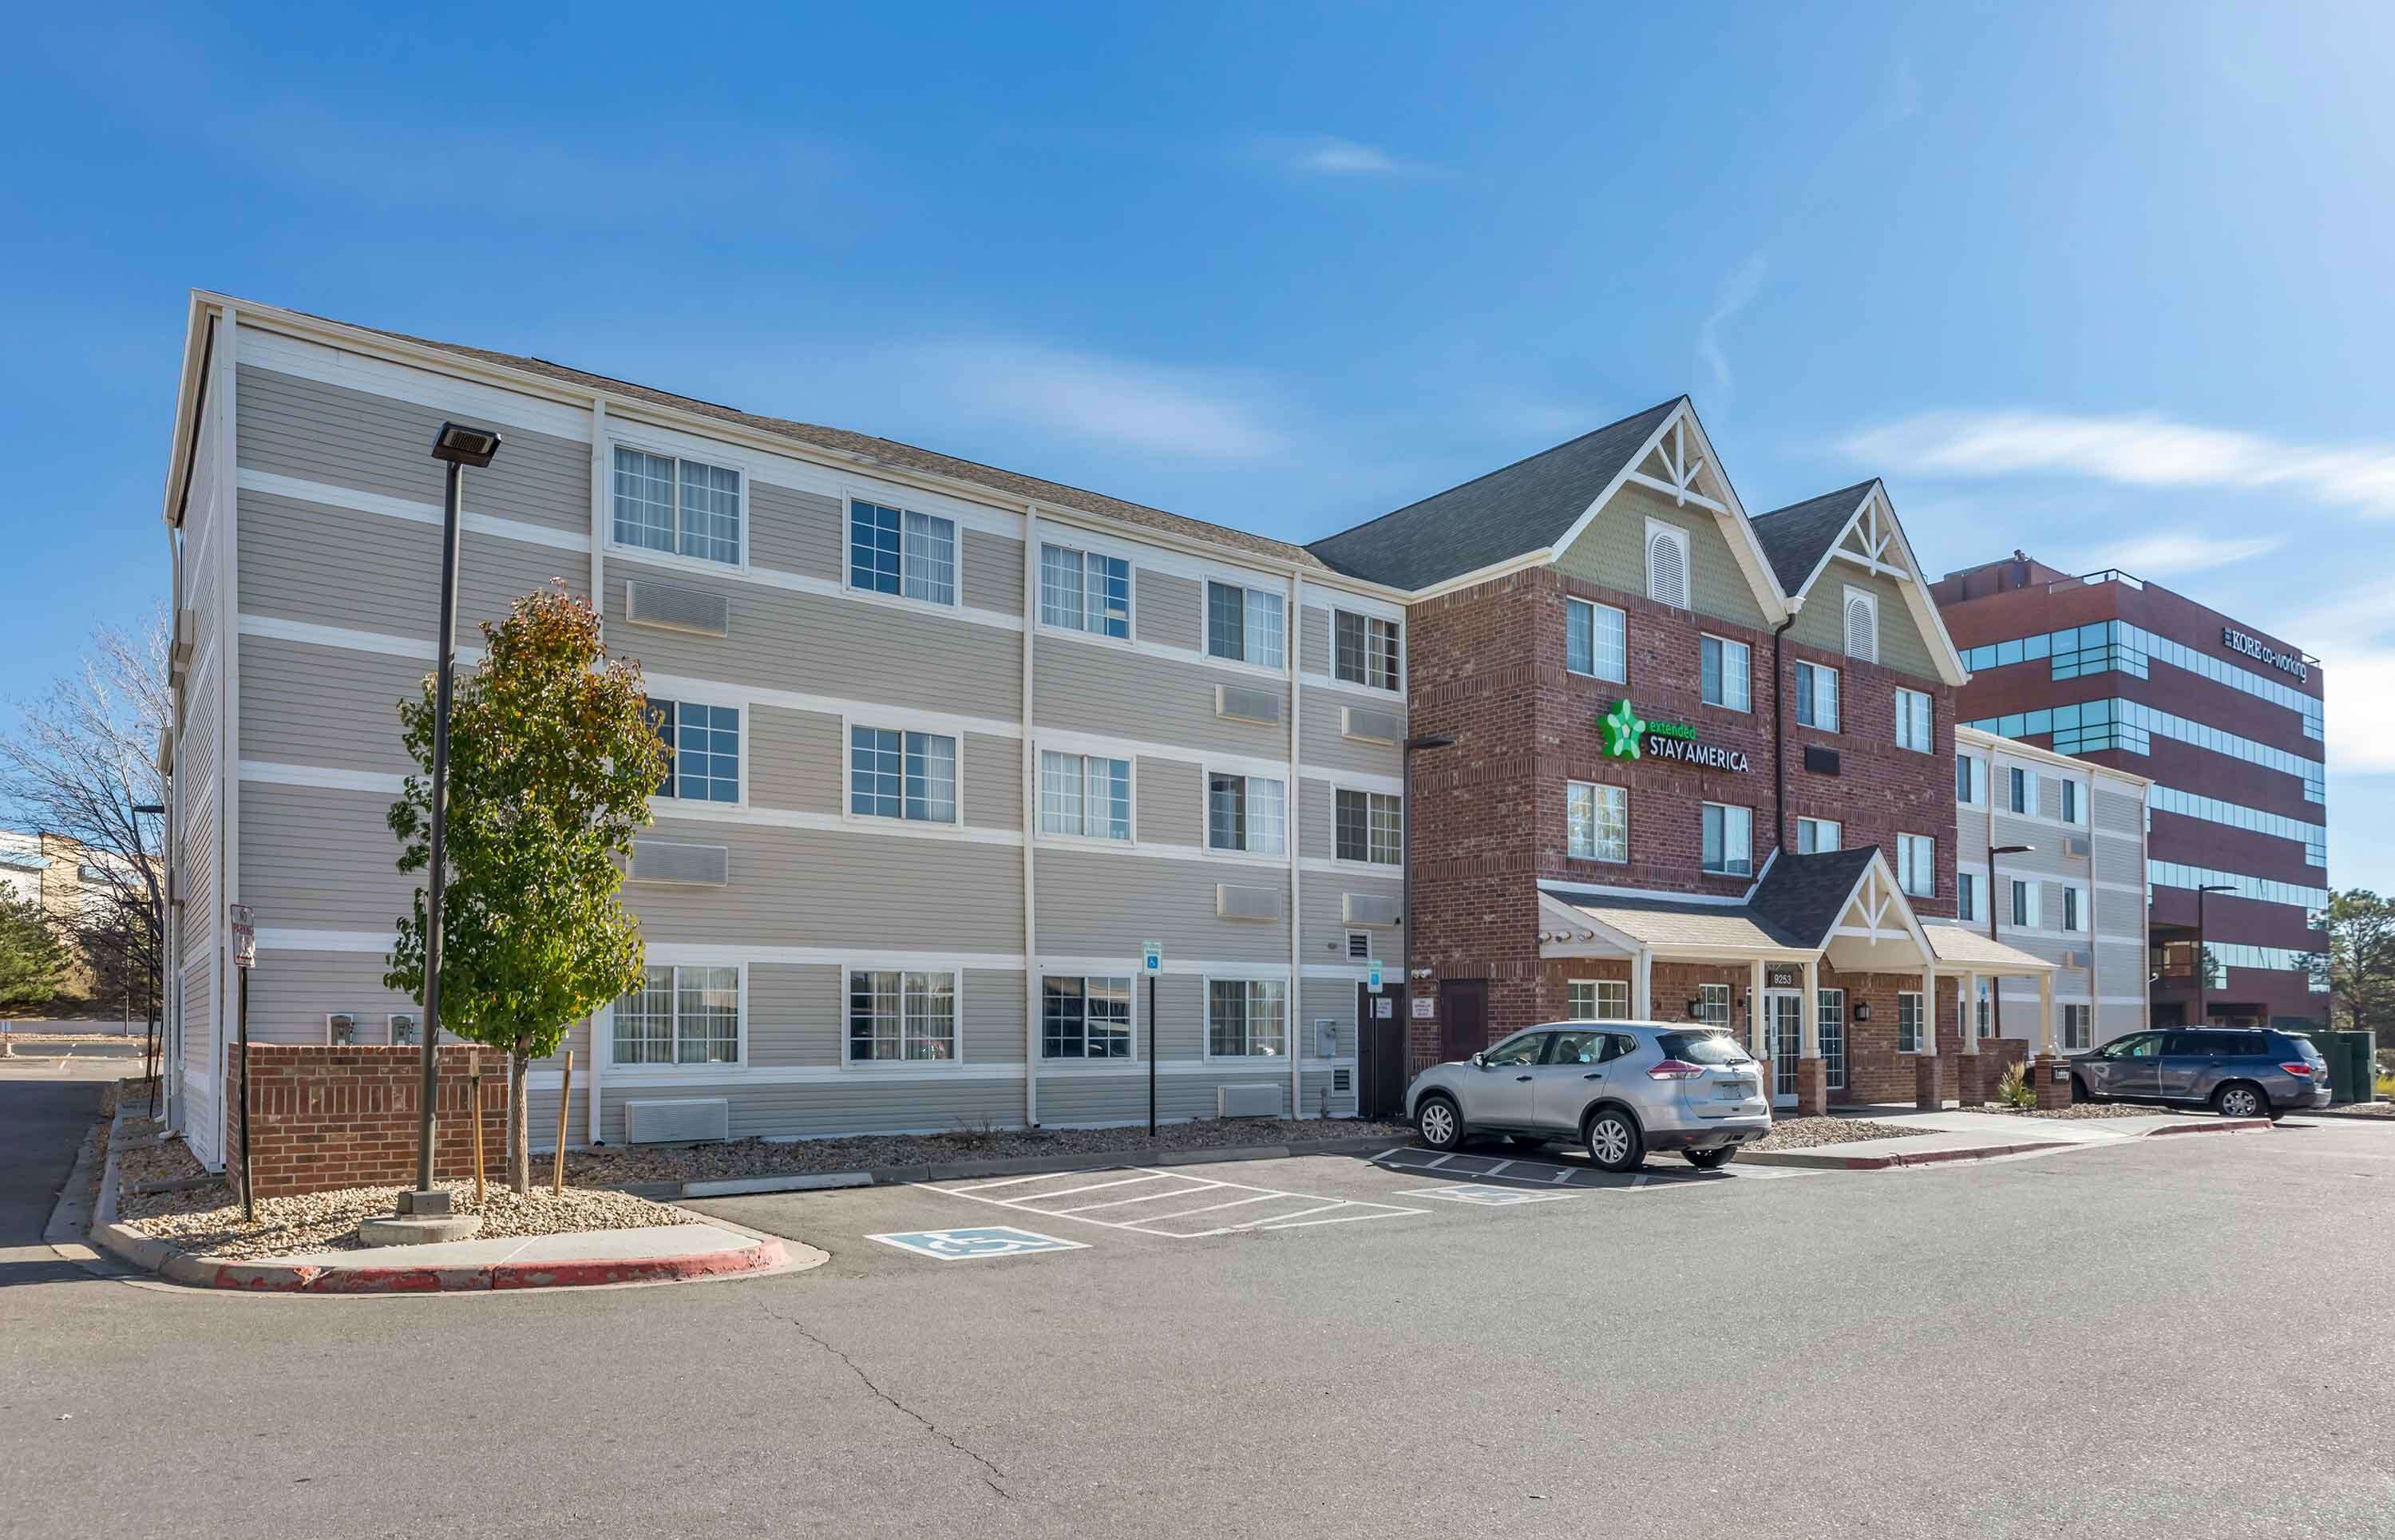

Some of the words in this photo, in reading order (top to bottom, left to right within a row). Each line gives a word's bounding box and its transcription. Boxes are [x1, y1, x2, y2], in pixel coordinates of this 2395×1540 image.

[2232, 631, 2262, 659] KORE
[2262, 647, 2306, 683] co-working
[1649, 721, 1696, 740] extended
[1649, 735, 1684, 760] STAY
[1684, 742, 1748, 773] AMERICA
[1775, 973, 1791, 984] 9253
